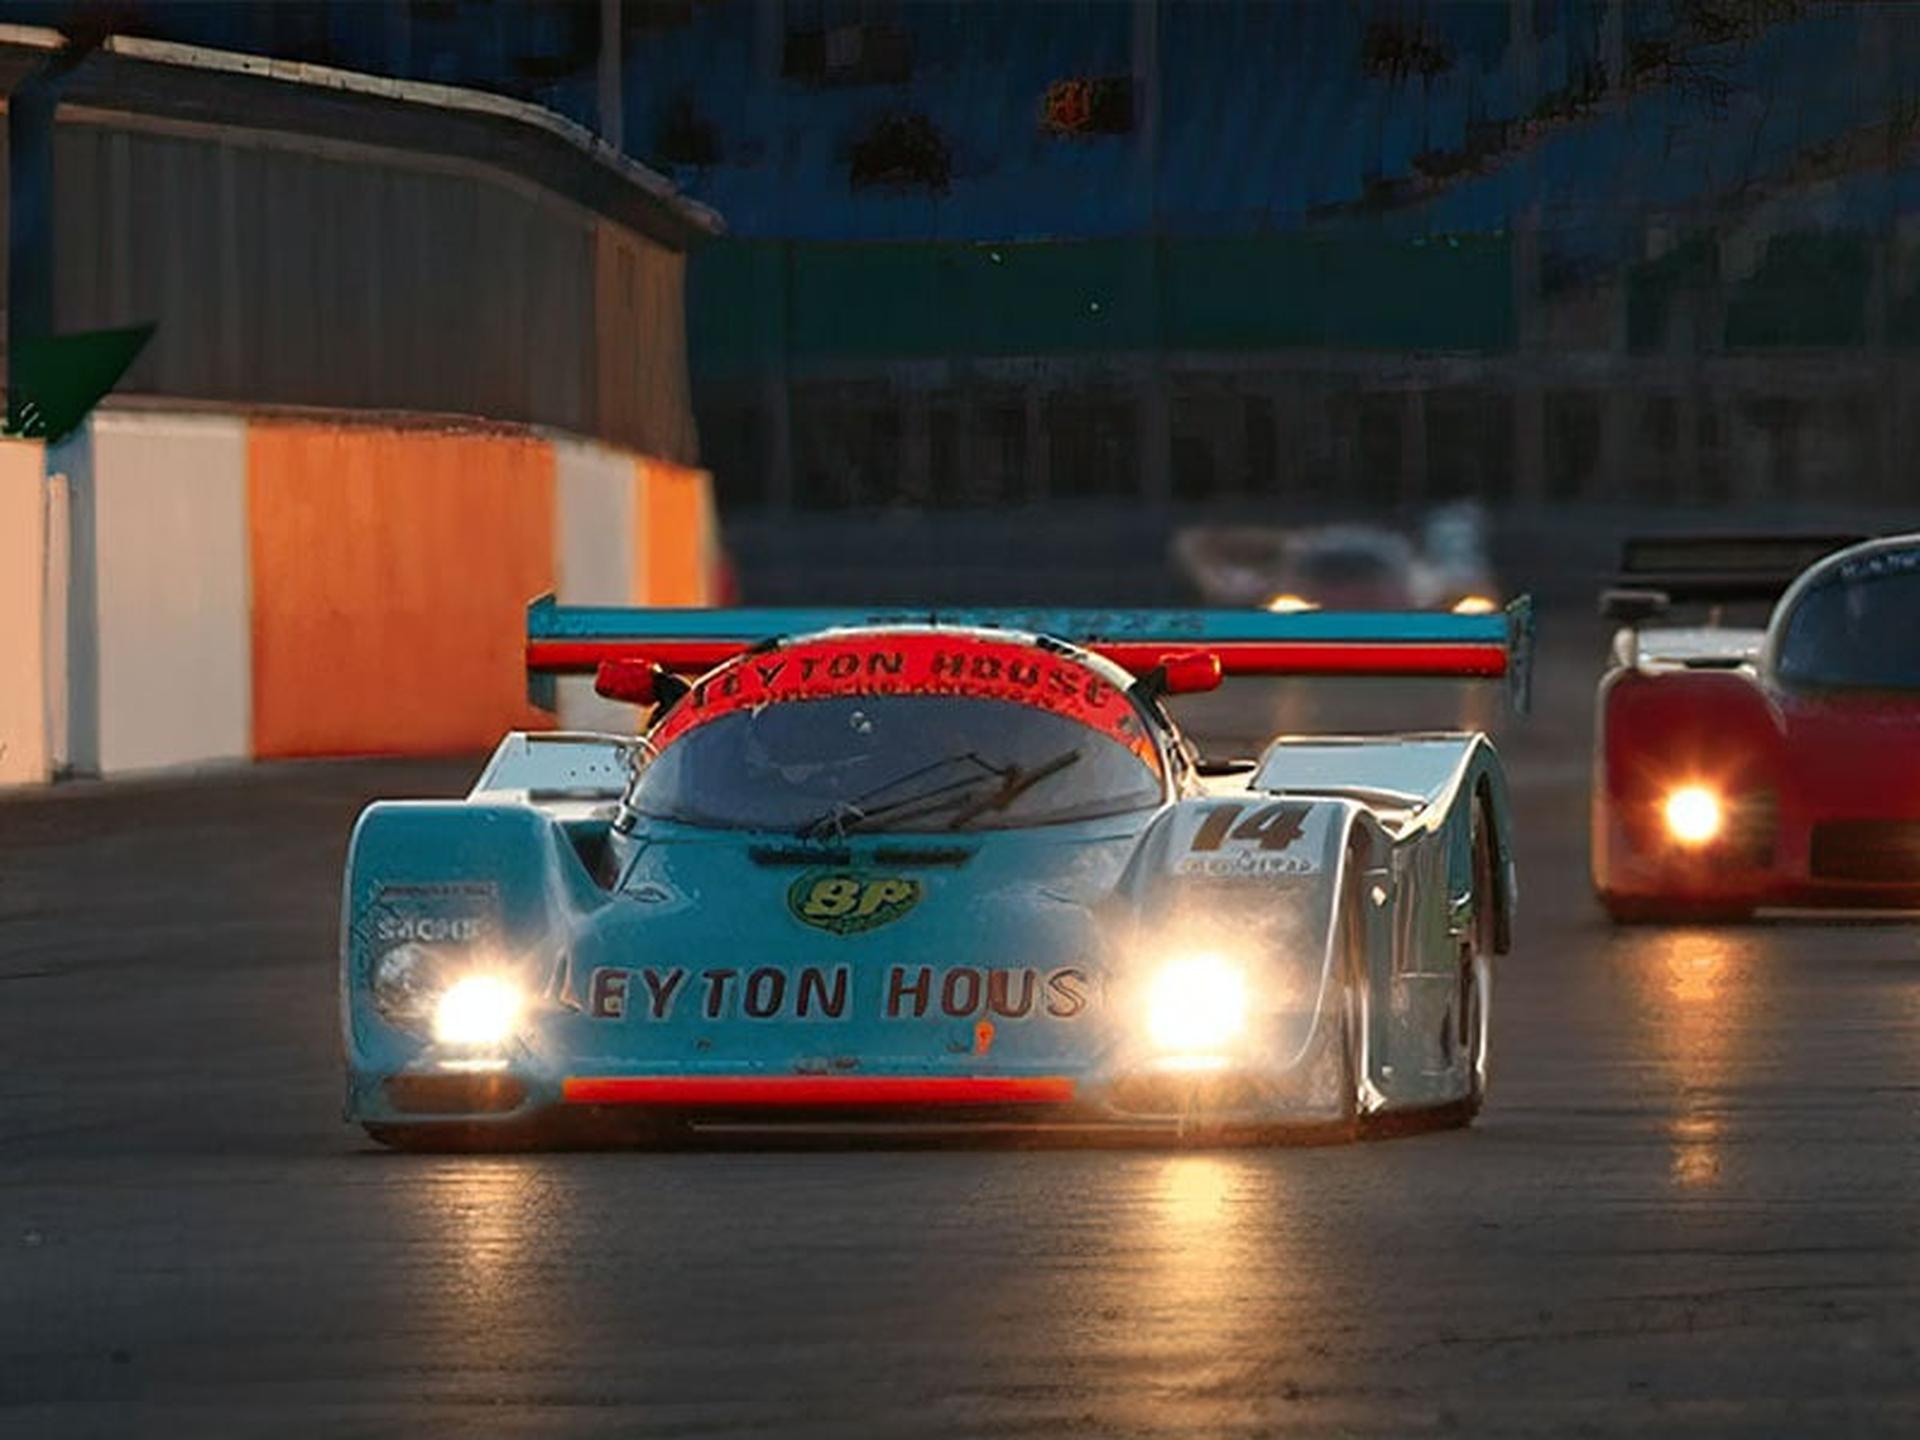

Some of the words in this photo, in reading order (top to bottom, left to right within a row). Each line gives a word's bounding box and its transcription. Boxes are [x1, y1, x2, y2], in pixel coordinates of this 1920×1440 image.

[1190, 801, 1316, 851] 14
[803, 878, 912, 916] BP
[568, 967, 850, 1020] EYTON
[885, 966, 1092, 1020] HOUS
